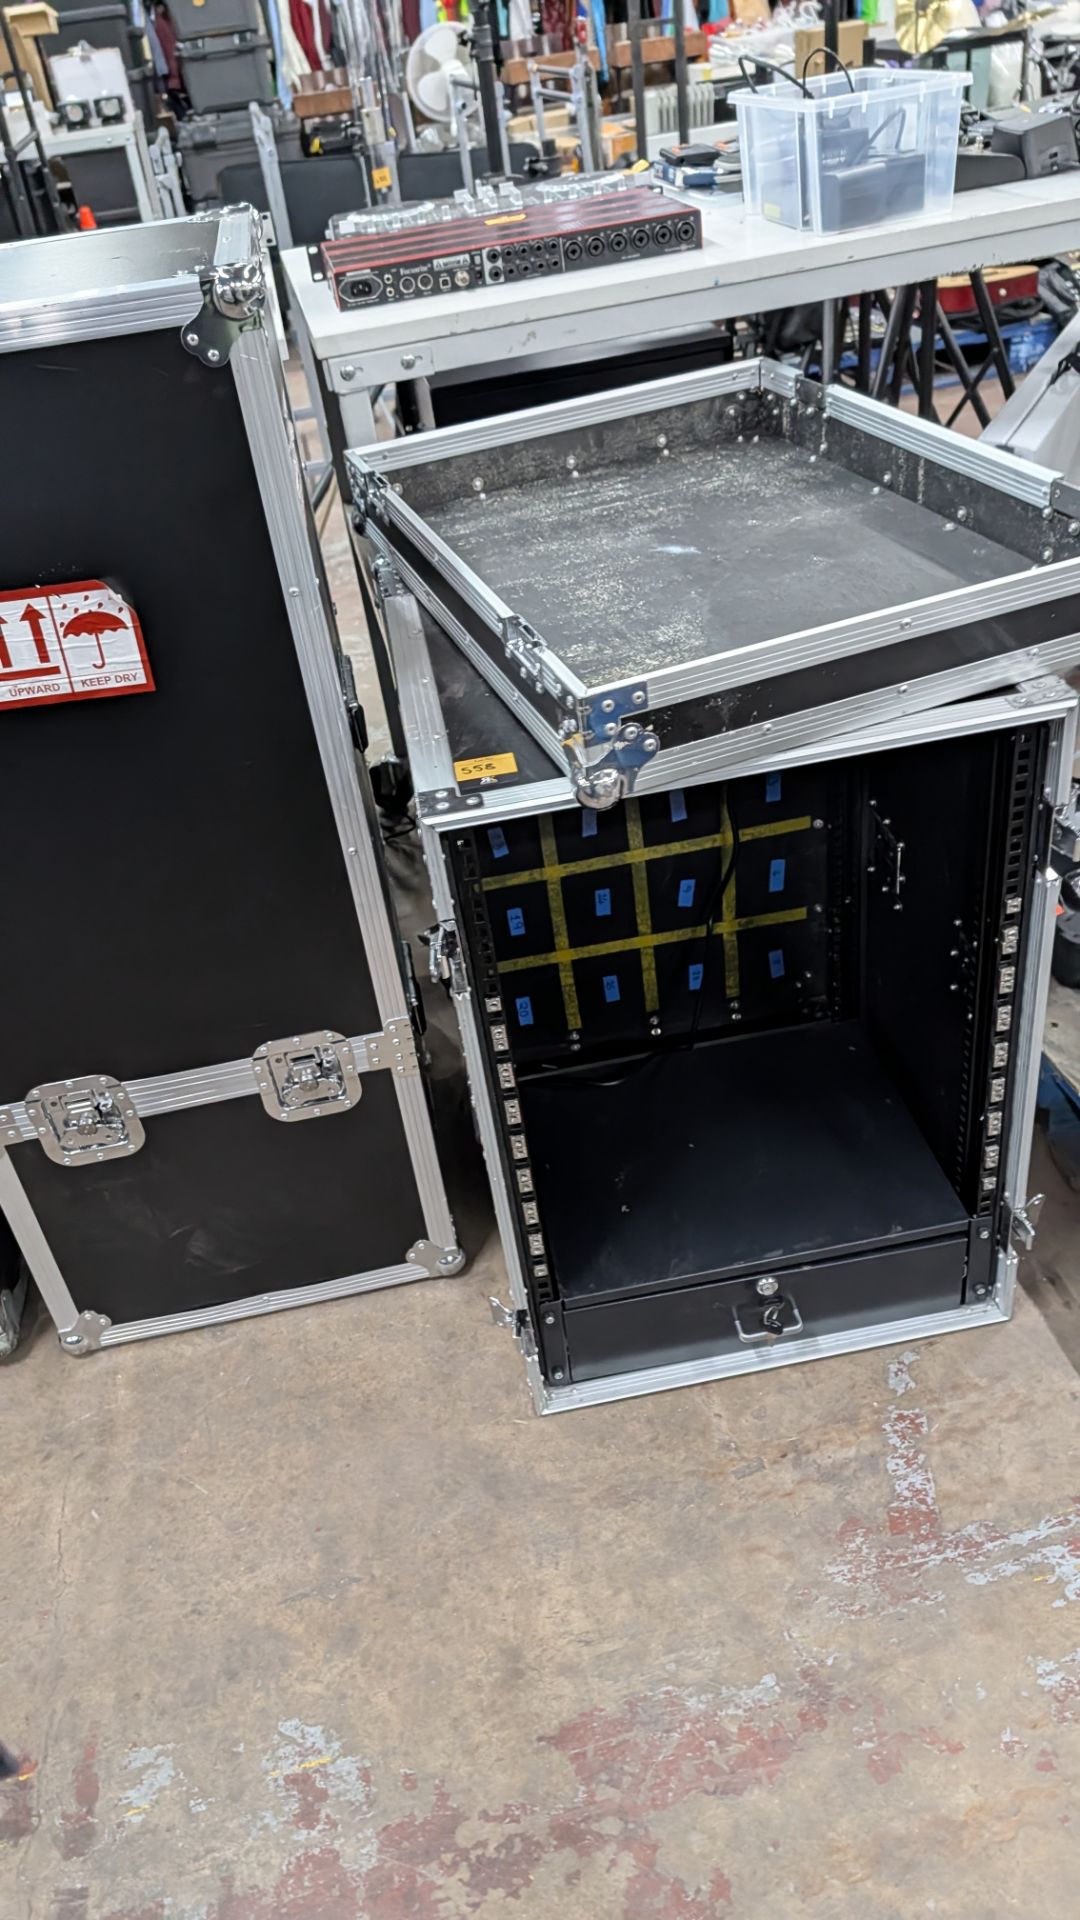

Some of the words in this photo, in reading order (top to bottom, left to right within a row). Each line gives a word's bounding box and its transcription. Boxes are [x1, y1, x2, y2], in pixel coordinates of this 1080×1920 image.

[81, 676, 111, 688] KEEP
[115, 672, 138, 683] DRY
[8, 683, 61, 697] UPWARD
[518, 1000, 529, 1018] 20
